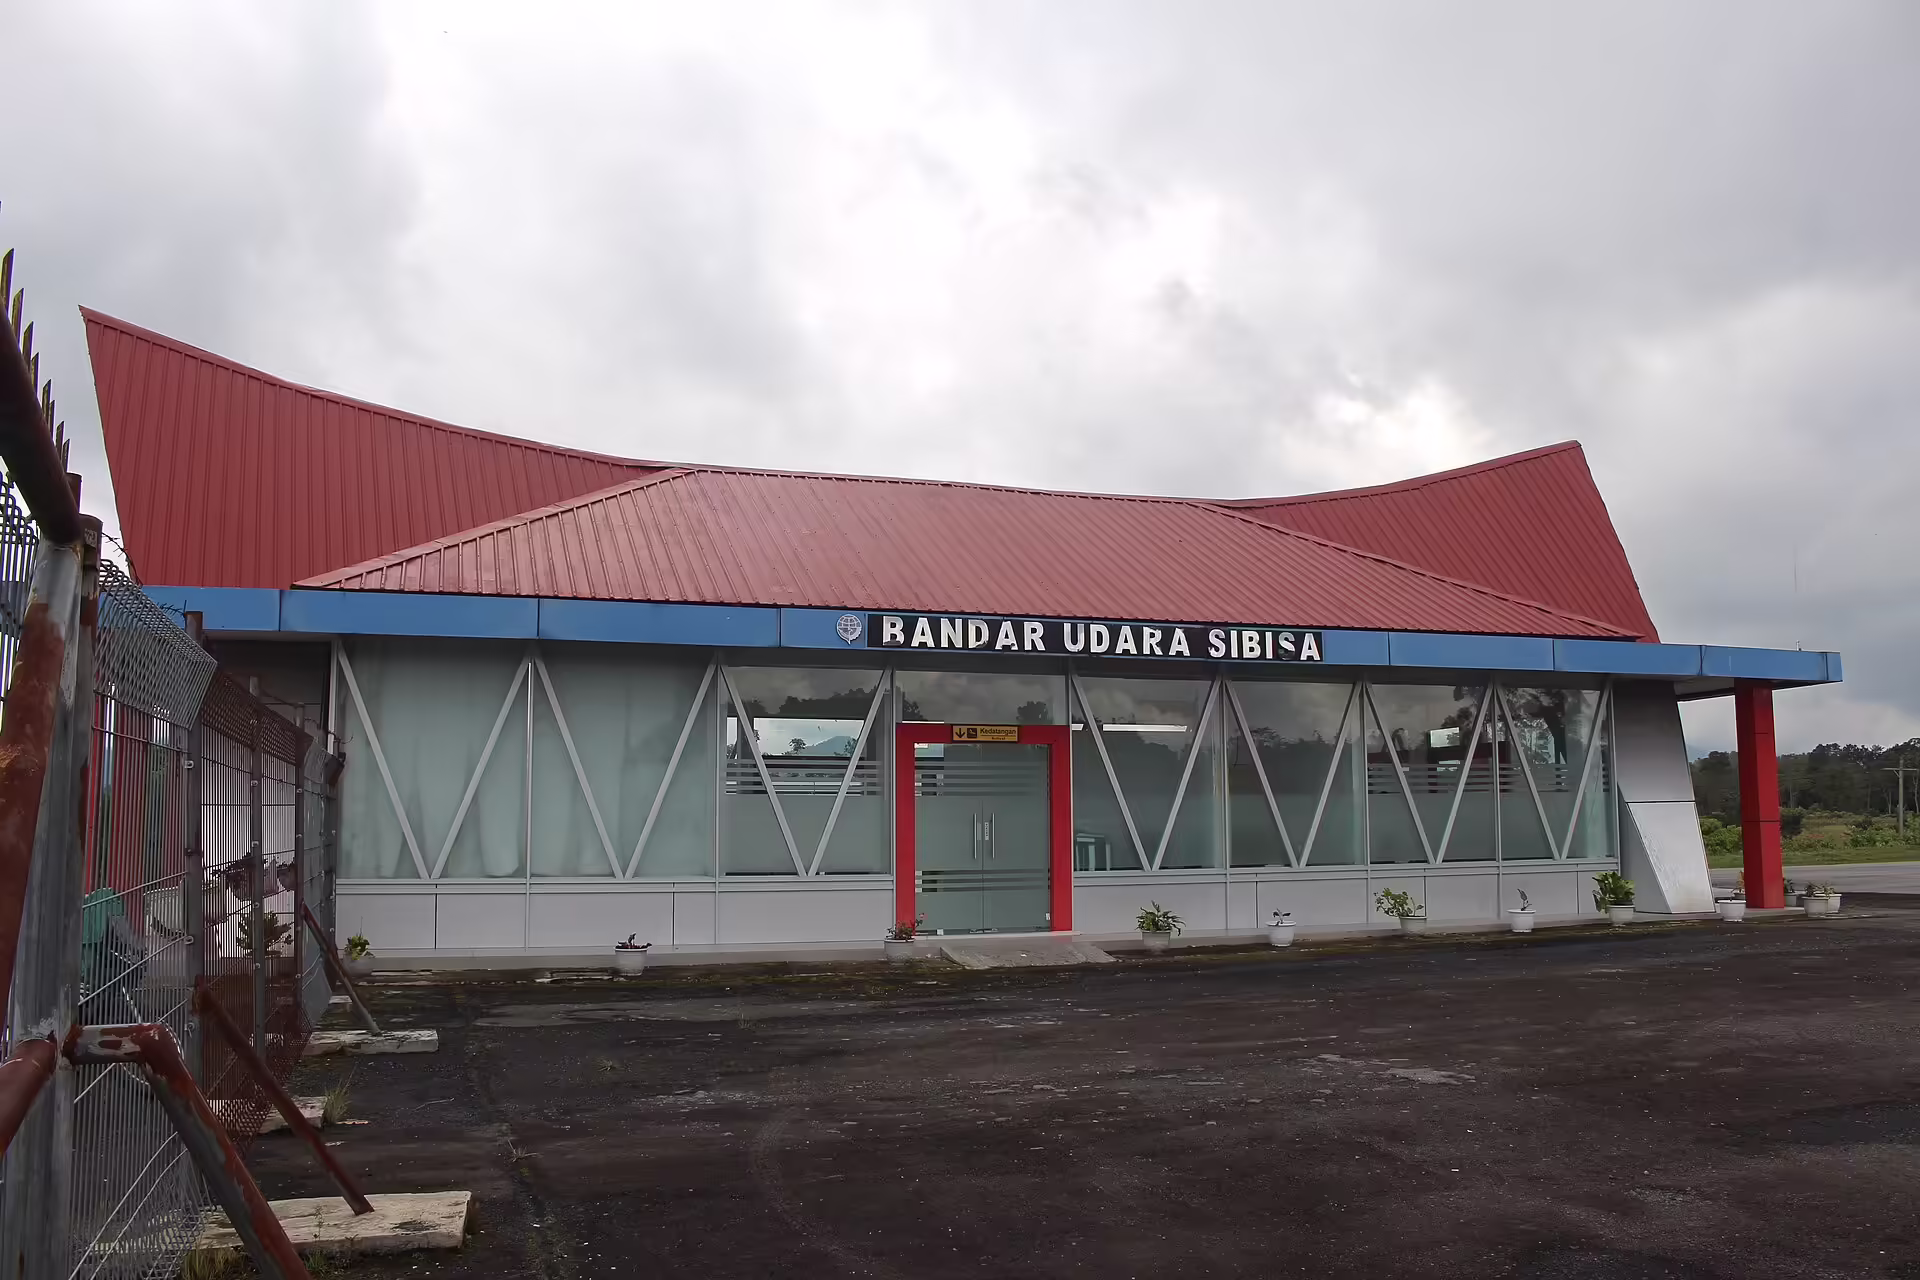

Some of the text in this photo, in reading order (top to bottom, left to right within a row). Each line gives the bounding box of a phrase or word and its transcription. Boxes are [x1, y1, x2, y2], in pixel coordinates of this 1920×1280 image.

[882, 616, 1320, 660] BANDAR UDARA SIBISA
[980, 727, 1016, 736] Kedatangan
